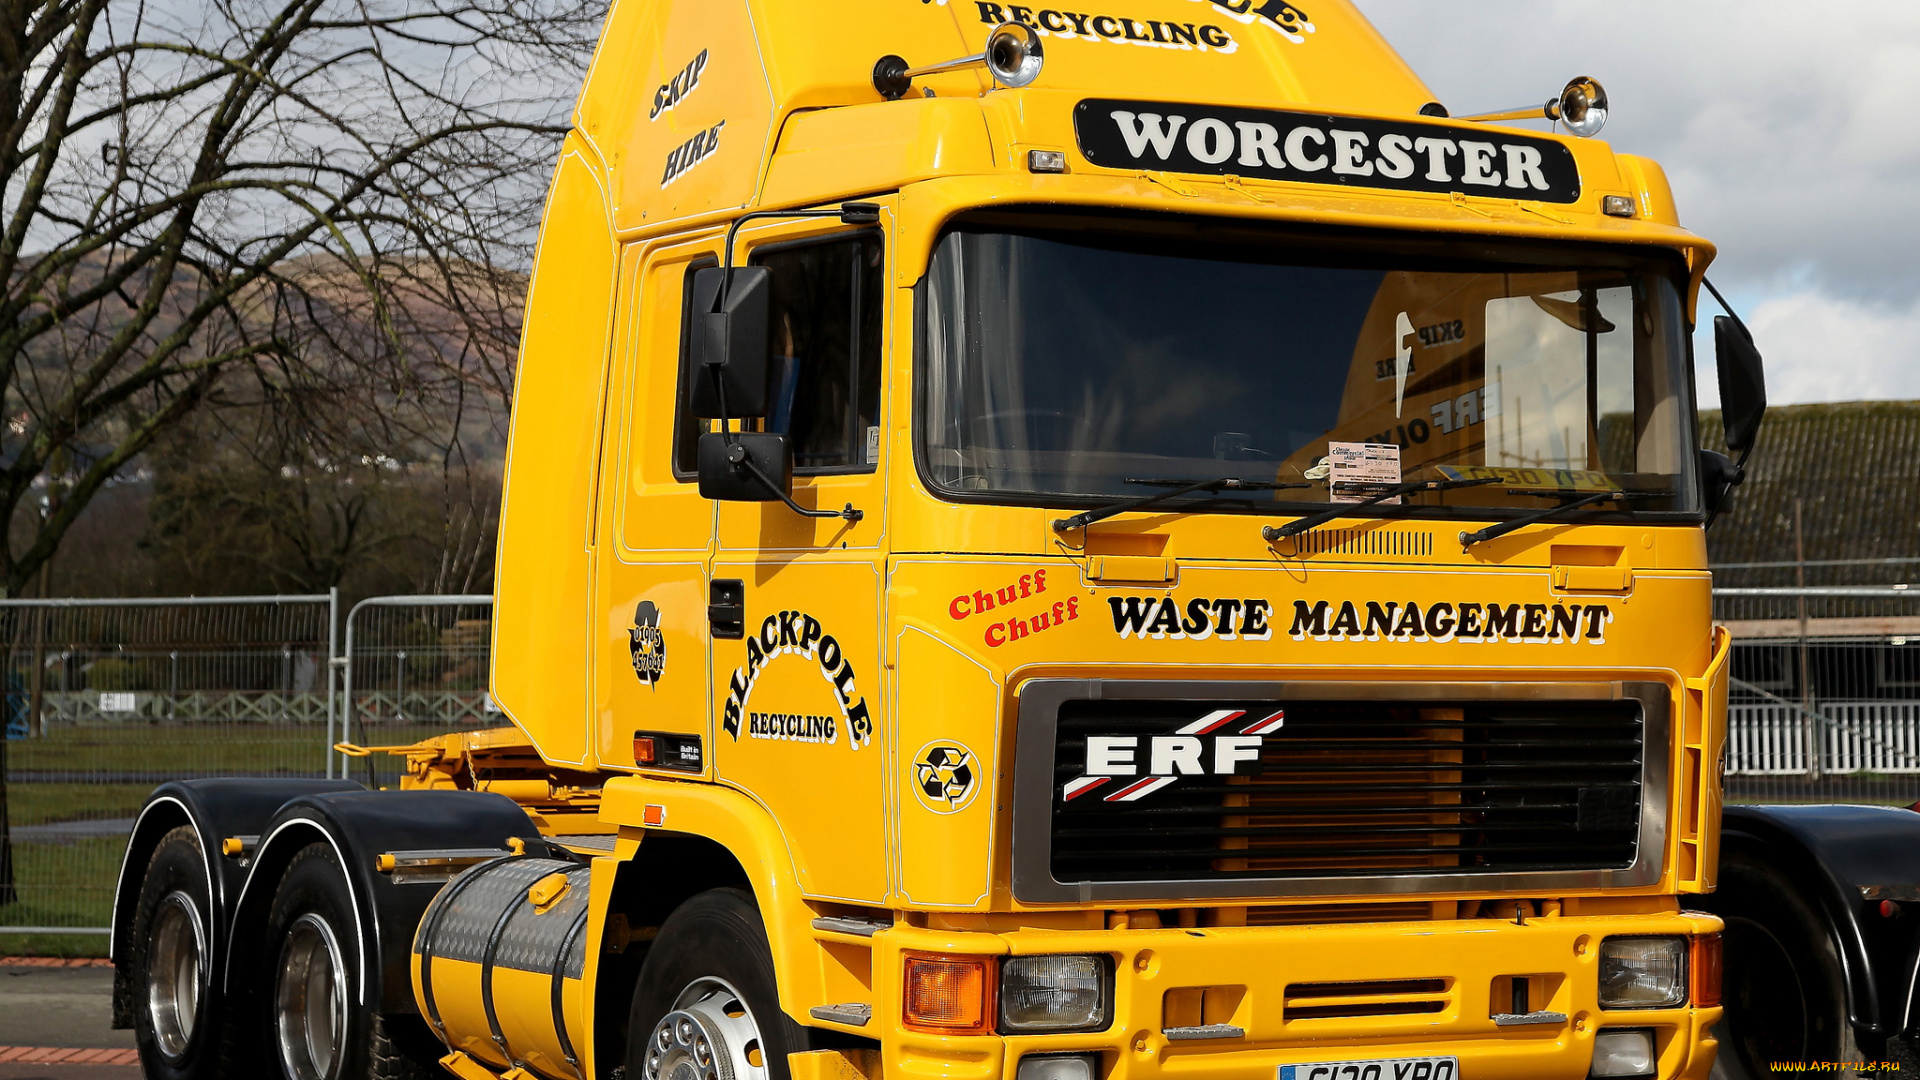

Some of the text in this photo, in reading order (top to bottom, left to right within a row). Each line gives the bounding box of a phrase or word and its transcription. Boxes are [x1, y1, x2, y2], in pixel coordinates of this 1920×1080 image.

[974, 1, 1233, 49] RECYCLING
[650, 48, 708, 121] SKIP
[661, 119, 725, 188] HIRE
[1110, 110, 1551, 191] WORCESTER
[949, 569, 1046, 620] Chuff
[984, 596, 1079, 648] Chuff
[1107, 597, 1614, 645] WASTE MANAGEMENT
[723, 610, 873, 749] BLACKPOLE
[750, 712, 837, 744] RECYCLING
[1086, 736, 1262, 775] ERF
